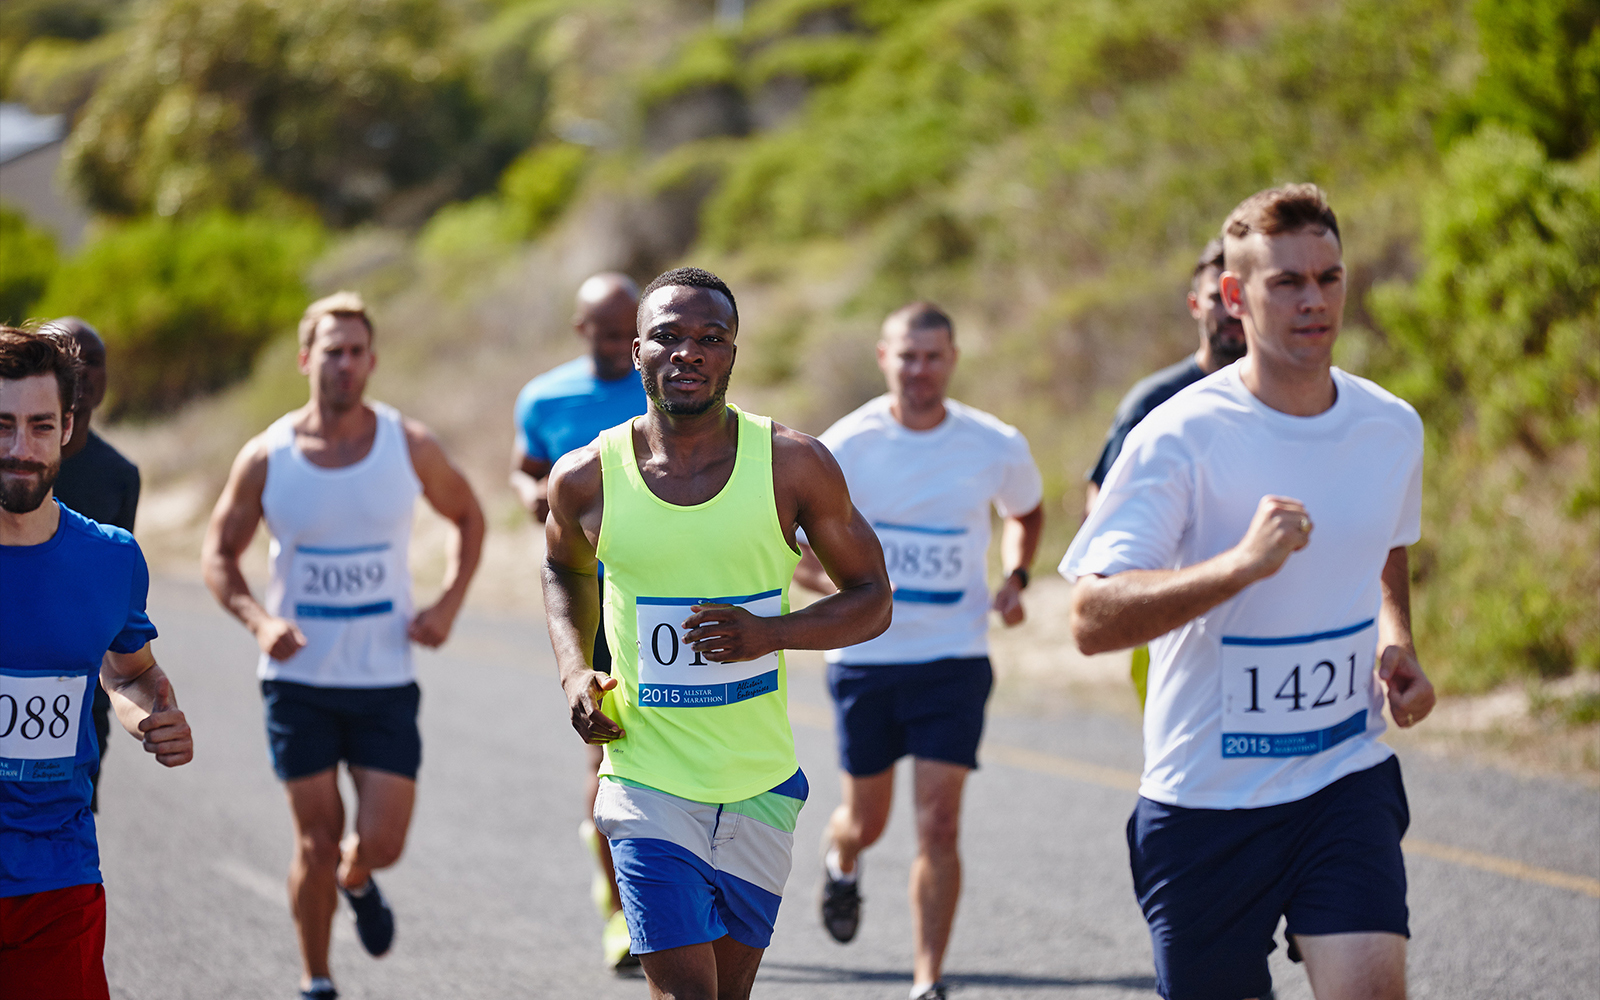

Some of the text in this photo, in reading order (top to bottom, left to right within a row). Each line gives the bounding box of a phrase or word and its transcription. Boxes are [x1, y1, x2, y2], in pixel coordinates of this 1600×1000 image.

[883, 542, 962, 580] 0855
[302, 562, 385, 597] 2089
[642, 688, 681, 704] 2015
[1244, 652, 1357, 713] 1421
[683, 696, 723, 704] MARATHON
[1225, 736, 1271, 755] 2015
